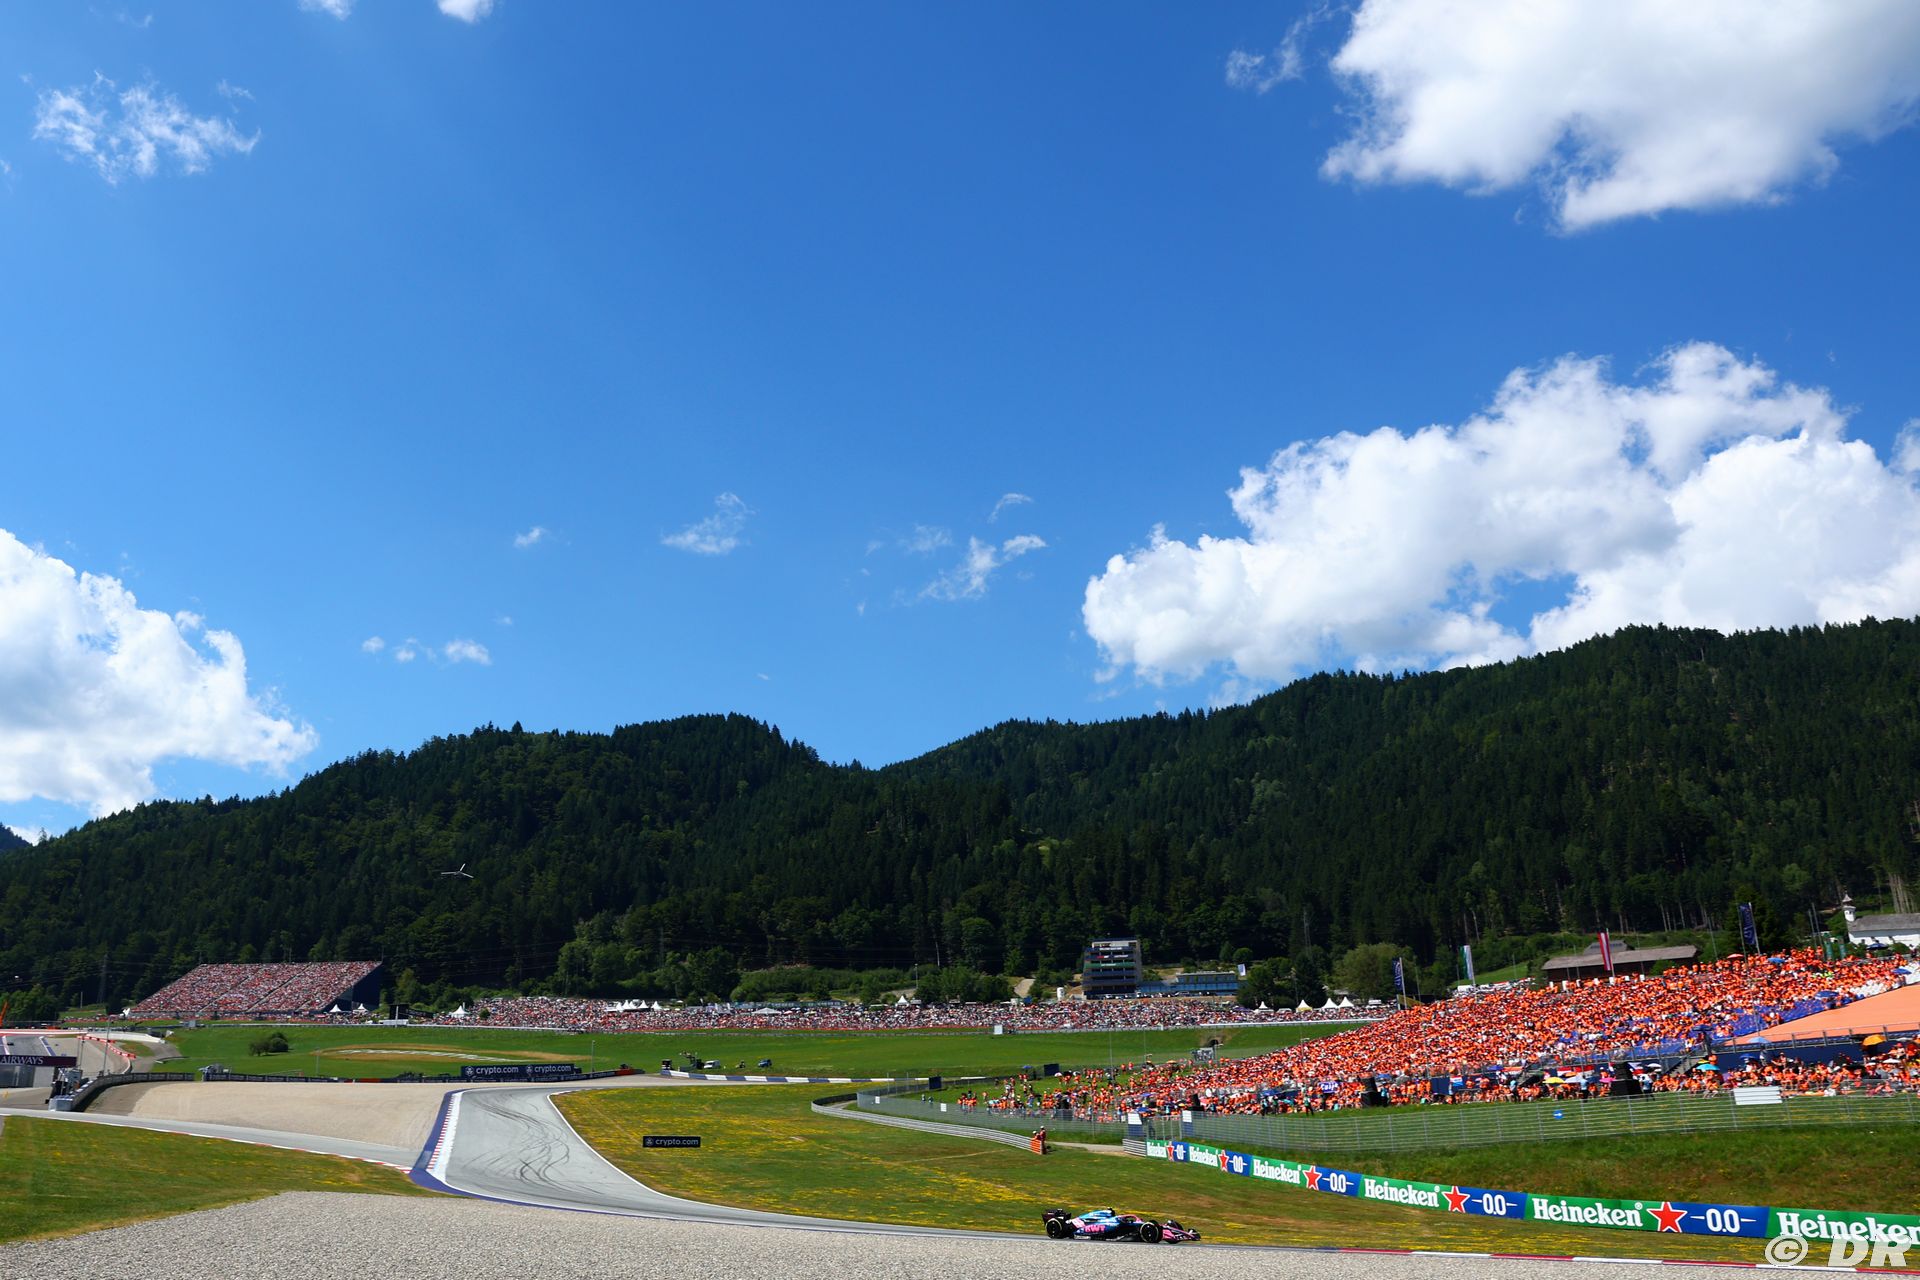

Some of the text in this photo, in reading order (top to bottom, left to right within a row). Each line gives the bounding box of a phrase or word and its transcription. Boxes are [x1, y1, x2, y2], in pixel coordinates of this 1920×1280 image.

[1, 1056, 44, 1065] AIRWAYS
[475, 1066, 519, 1075] crypto.com
[534, 1065, 571, 1074] crypto.com
[655, 1138, 699, 1146] crypto.com
[1253, 1159, 1301, 1184] Heineken
[1364, 1178, 1440, 1207] Heineken
[1532, 1197, 1643, 1228] Heineken
